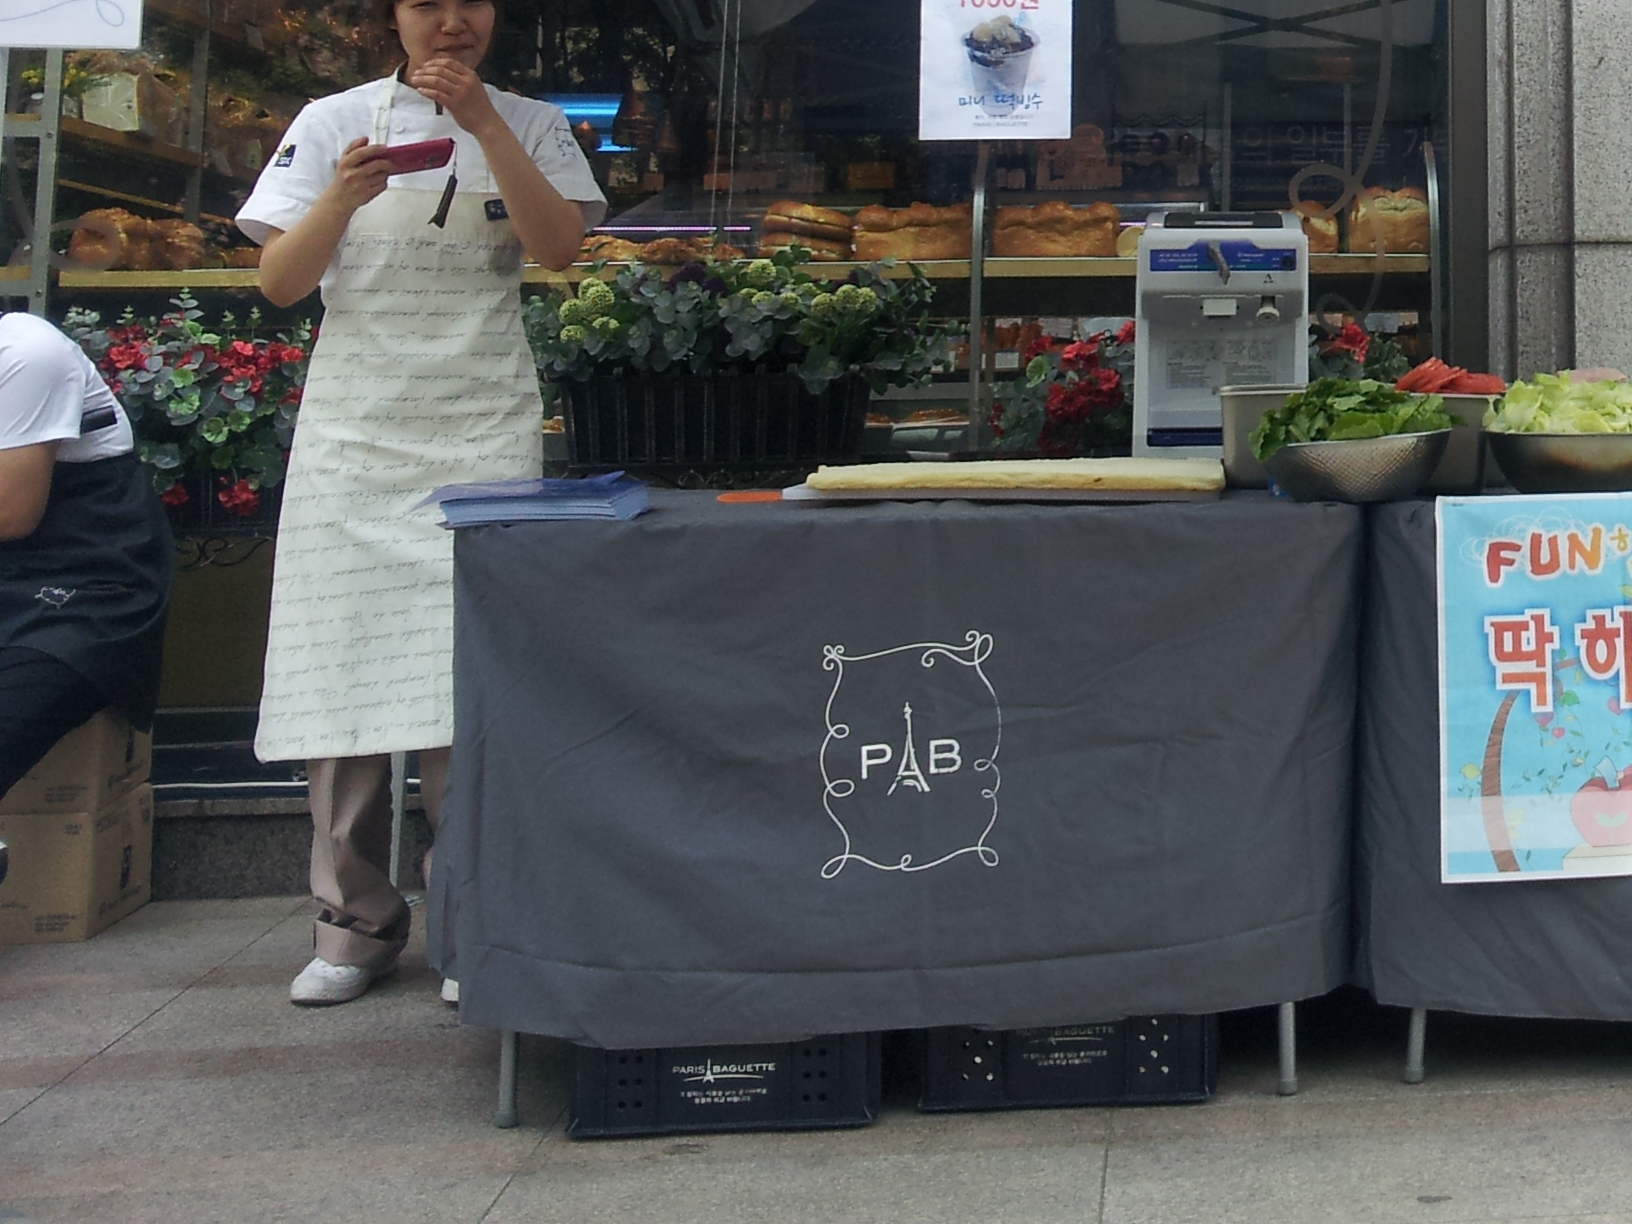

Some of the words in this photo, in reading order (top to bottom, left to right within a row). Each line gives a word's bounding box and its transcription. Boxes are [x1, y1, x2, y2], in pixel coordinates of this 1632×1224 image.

[994, 92, 1044, 111] 떡빙수
[1484, 607, 1558, 712] 딱
[860, 743, 893, 780] P
[928, 738, 963, 774] B
[672, 1065, 705, 1074] PARIS
[712, 1062, 776, 1073] BAGUETTE
